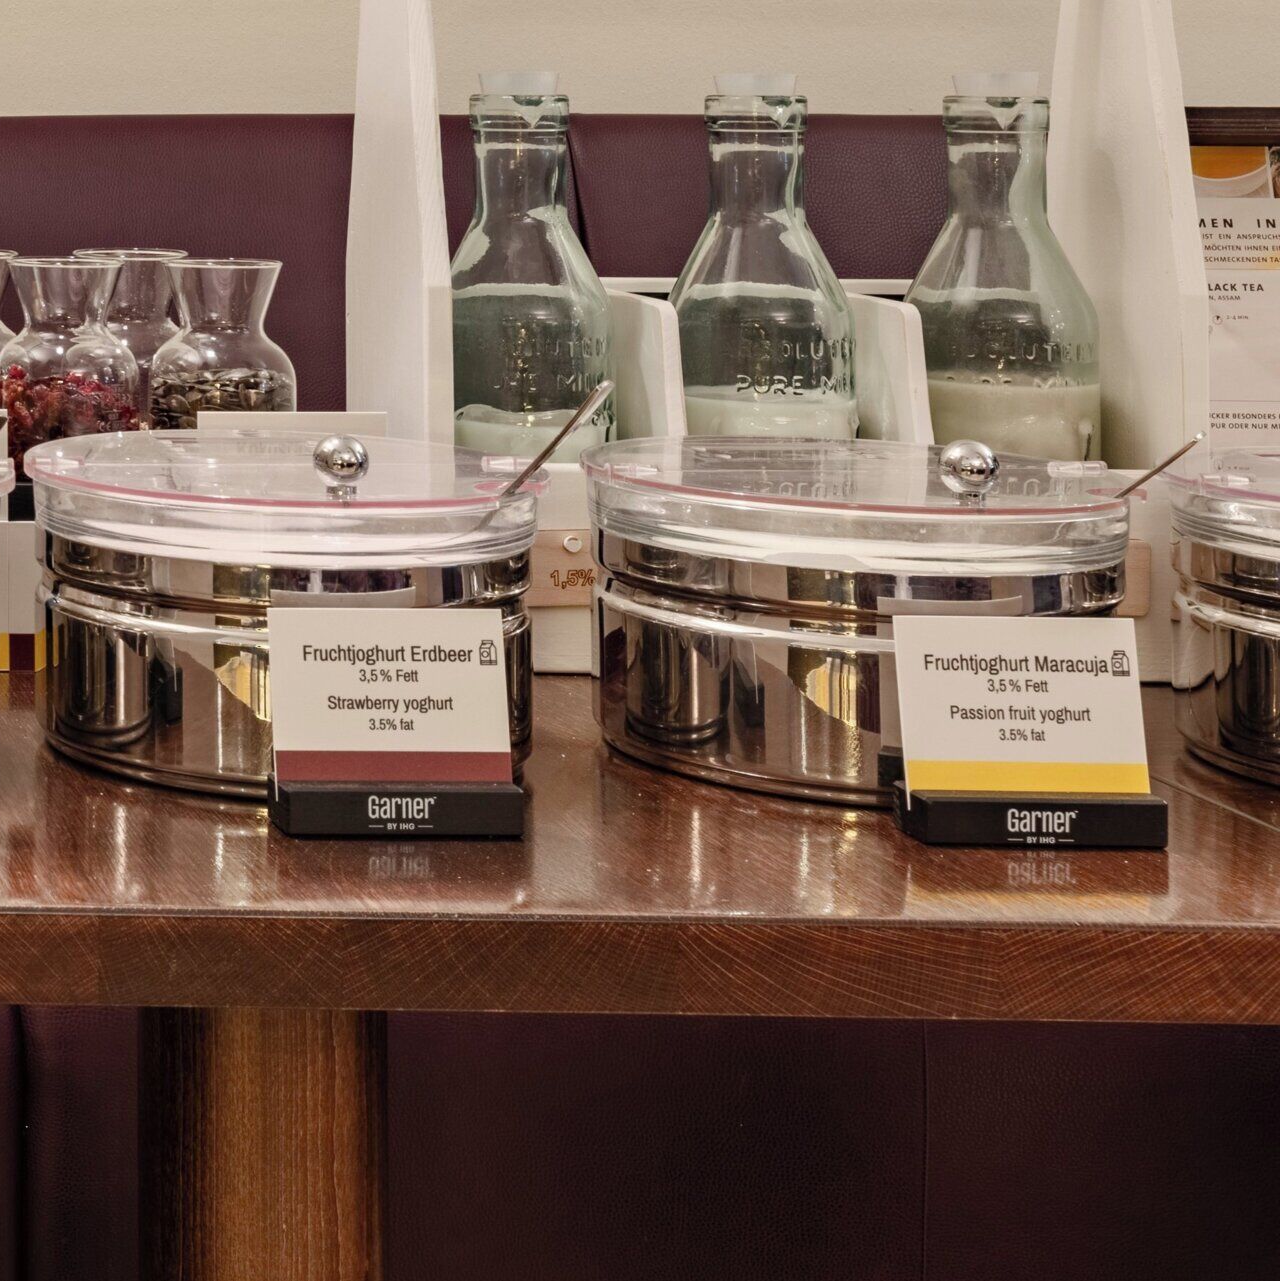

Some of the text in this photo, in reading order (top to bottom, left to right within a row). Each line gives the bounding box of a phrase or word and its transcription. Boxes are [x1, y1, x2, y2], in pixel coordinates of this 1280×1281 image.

[1256, 218, 1277, 229] IN
[1204, 244, 1242, 252] MÖCHTEN
[1207, 283, 1265, 292] LACK TEA
[736, 374, 804, 396] PURE
[1251, 422, 1269, 430] NUR
[302, 645, 473, 666] Fruchtjoghurt Erdbeer
[924, 654, 1109, 676] Fruchtjoghurt Maracuja
[396, 669, 419, 682] Fett
[1025, 679, 1049, 693] Fett
[327, 695, 453, 713] Strawberry yoghurt
[950, 705, 1091, 724] Passion fruit yoghurt
[368, 718, 414, 731] 3.5% fat
[999, 728, 1046, 742] 3.5% fat
[368, 795, 435, 819] Garner
[387, 822, 415, 830] BY IHG
[1007, 808, 1076, 833] Garner
[1026, 836, 1056, 844] BY IHG
